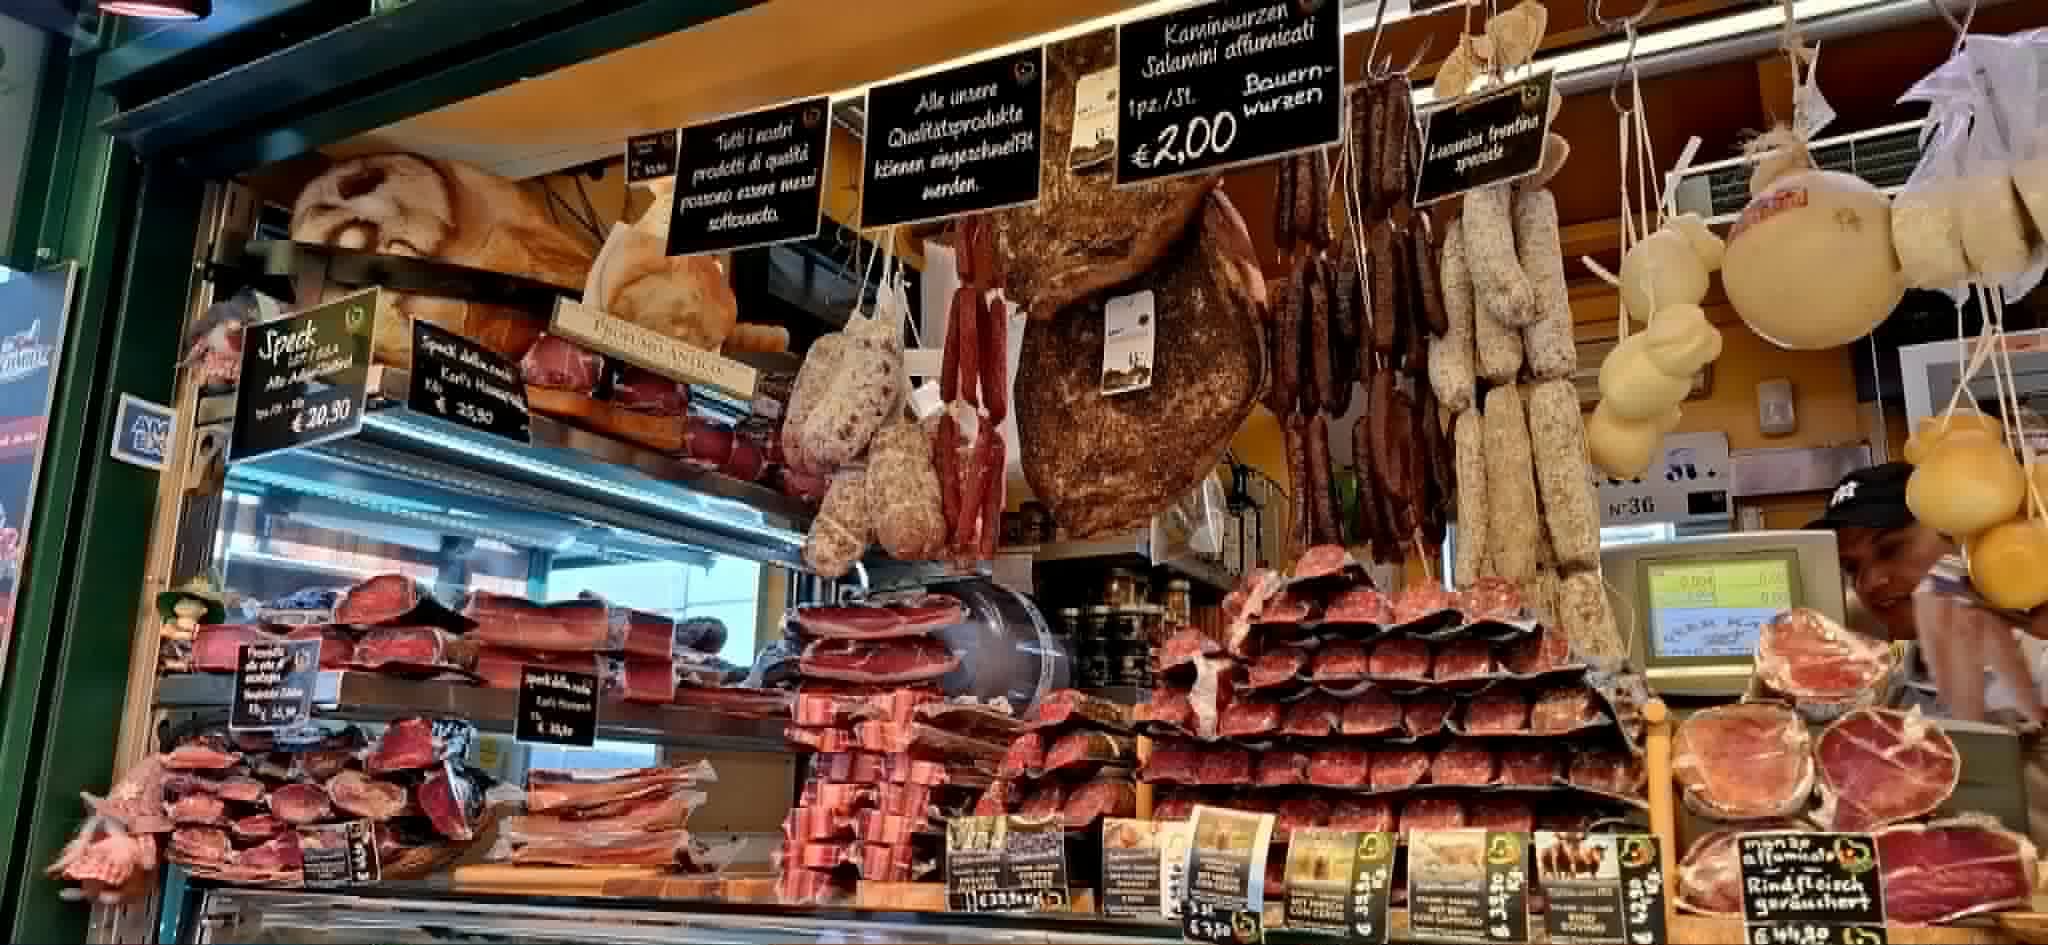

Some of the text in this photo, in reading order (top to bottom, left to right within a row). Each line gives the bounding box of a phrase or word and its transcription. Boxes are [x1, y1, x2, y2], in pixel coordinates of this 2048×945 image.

[1164, 2, 1289, 47] Kaminwurzen
[1141, 15, 1315, 78] Salamini affumicati
[913, 82, 998, 115] Alle unsere
[1242, 87, 1323, 118] wurzen
[712, 127, 745, 152] Tutti
[755, 119, 794, 144] nostri
[1488, 112, 1539, 143] trentina
[691, 155, 746, 189] prodotti
[748, 151, 763, 173] di
[678, 188, 734, 216] possono
[736, 182, 777, 201] essere
[257, 319, 318, 367] Speck
[1746, 873, 1865, 896] Rindfleisch
[1754, 892, 1872, 918] geräuchert
